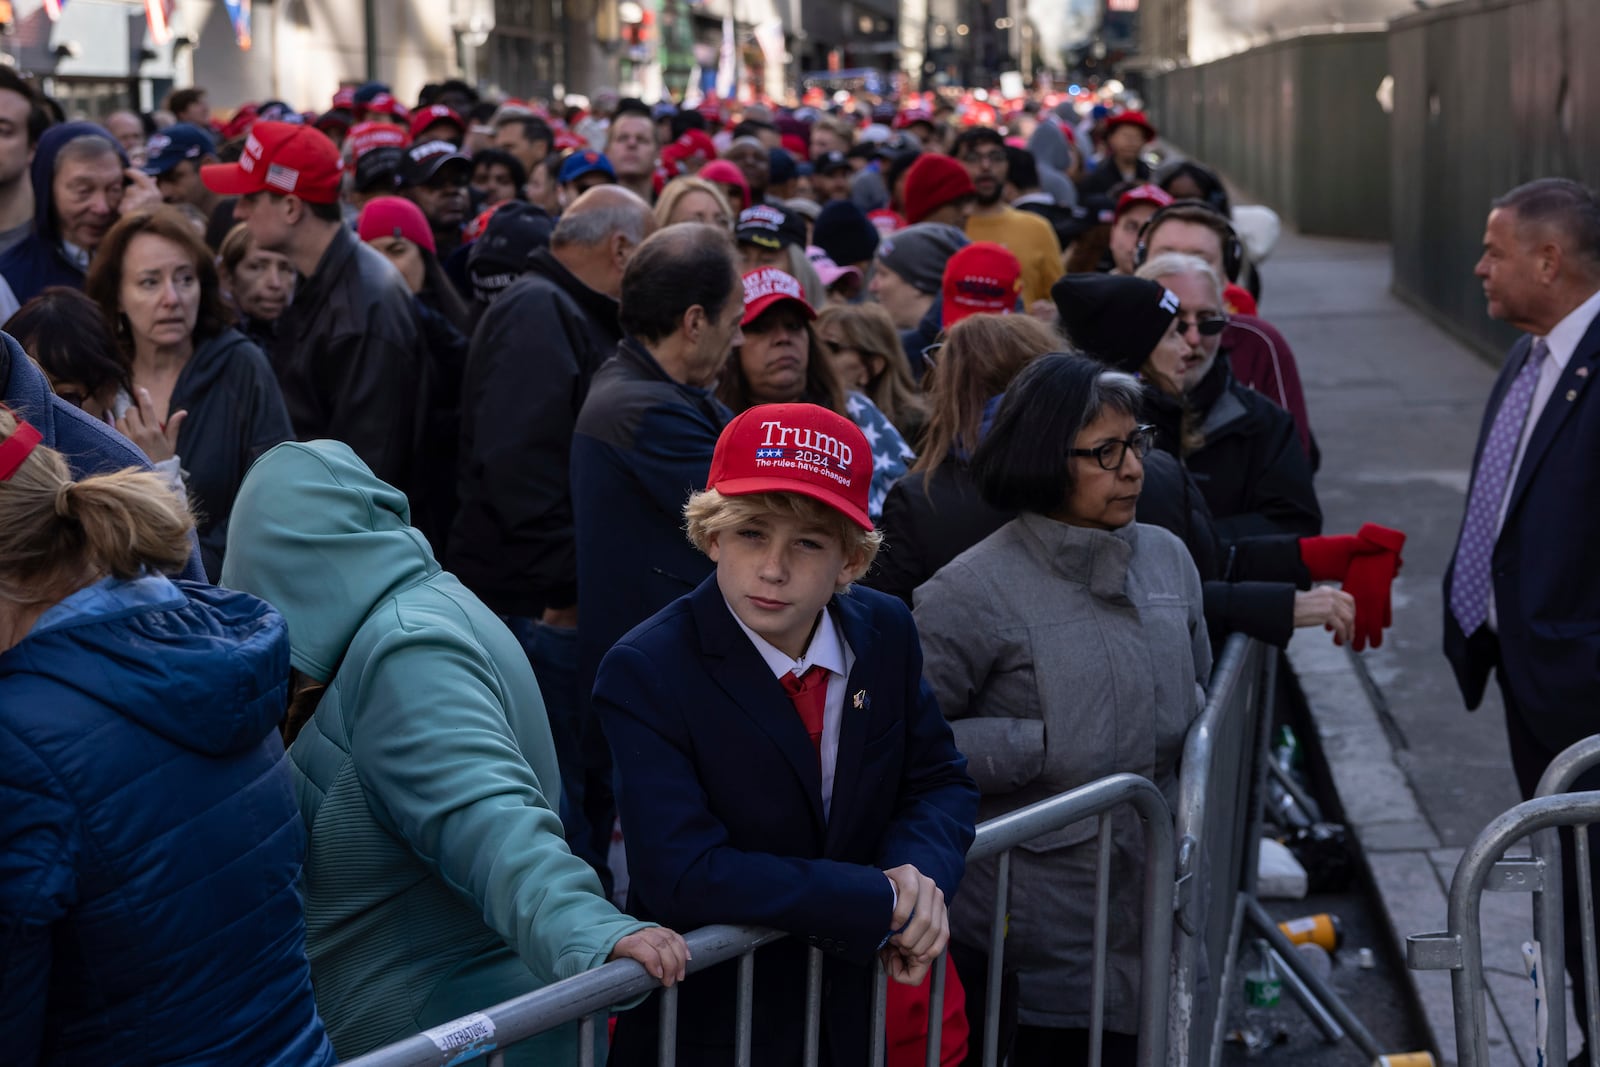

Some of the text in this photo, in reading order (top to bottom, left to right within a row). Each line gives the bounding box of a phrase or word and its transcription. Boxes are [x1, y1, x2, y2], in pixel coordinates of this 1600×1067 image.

[760, 421, 853, 470] Trump
[795, 450, 829, 468] 2024
[755, 459, 851, 487] The rules have changed
